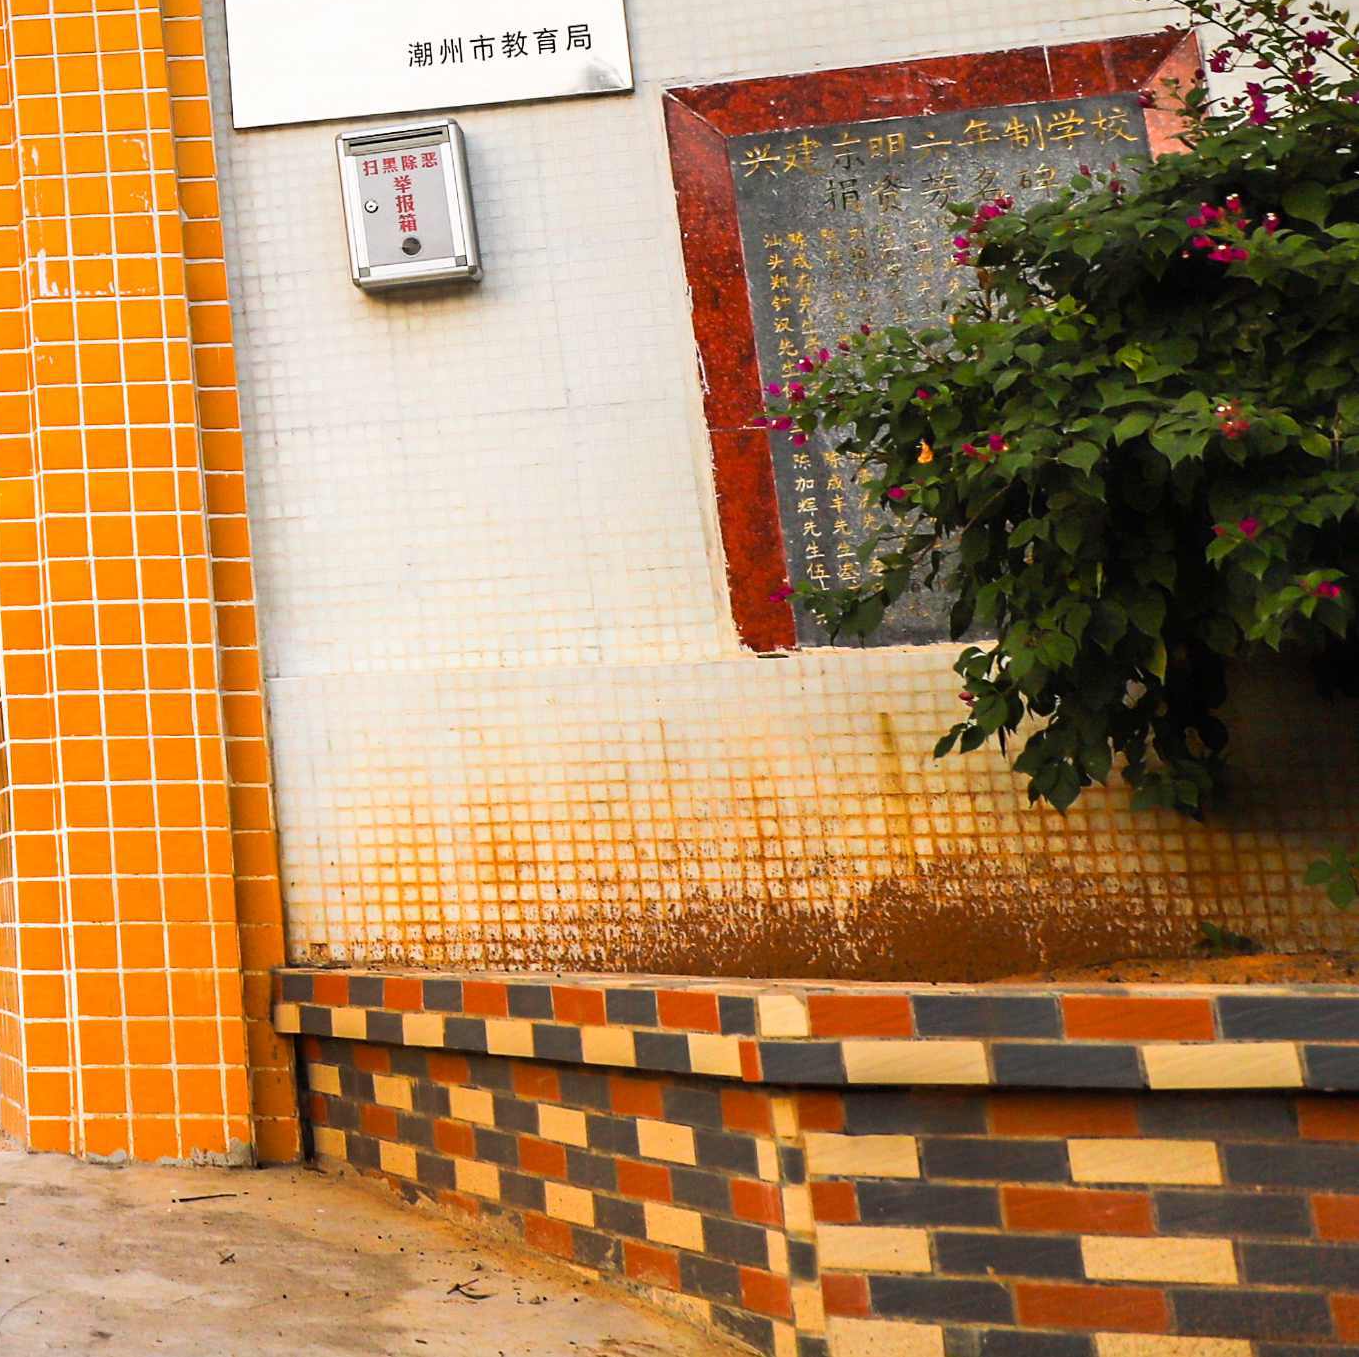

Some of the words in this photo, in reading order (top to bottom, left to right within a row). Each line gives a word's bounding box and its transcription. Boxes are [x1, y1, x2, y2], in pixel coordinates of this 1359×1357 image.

[408, 23, 593, 68] 潮州市教育局
[362, 151, 439, 177] 扫黑除恶
[394, 175, 418, 233] 举报箱
